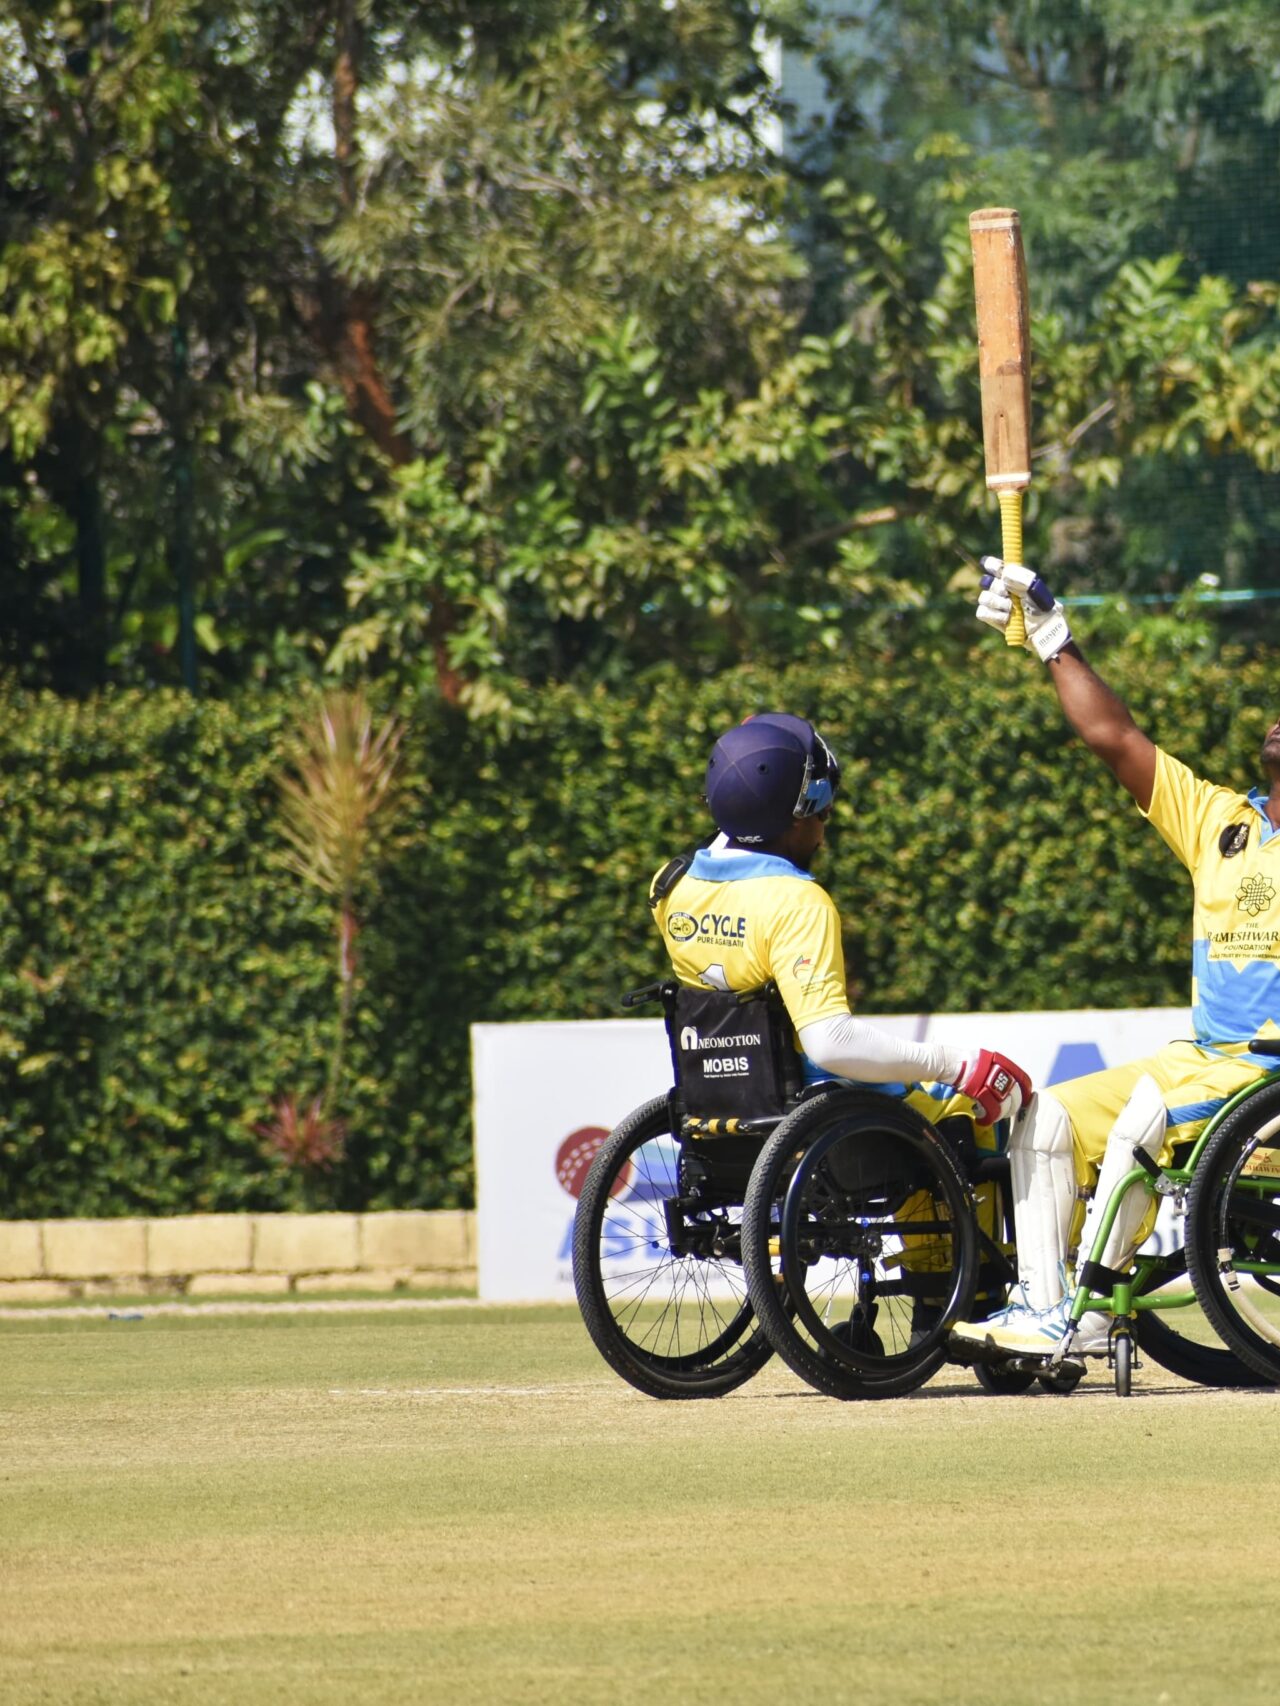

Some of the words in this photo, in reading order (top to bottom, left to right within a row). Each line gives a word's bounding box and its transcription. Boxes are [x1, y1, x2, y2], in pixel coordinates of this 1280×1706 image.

[700, 914, 746, 938] CYCLE
[697, 936, 714, 945] PURE
[698, 1034, 761, 1049] NEOMOTION
[703, 1057, 749, 1073] MOBIS
